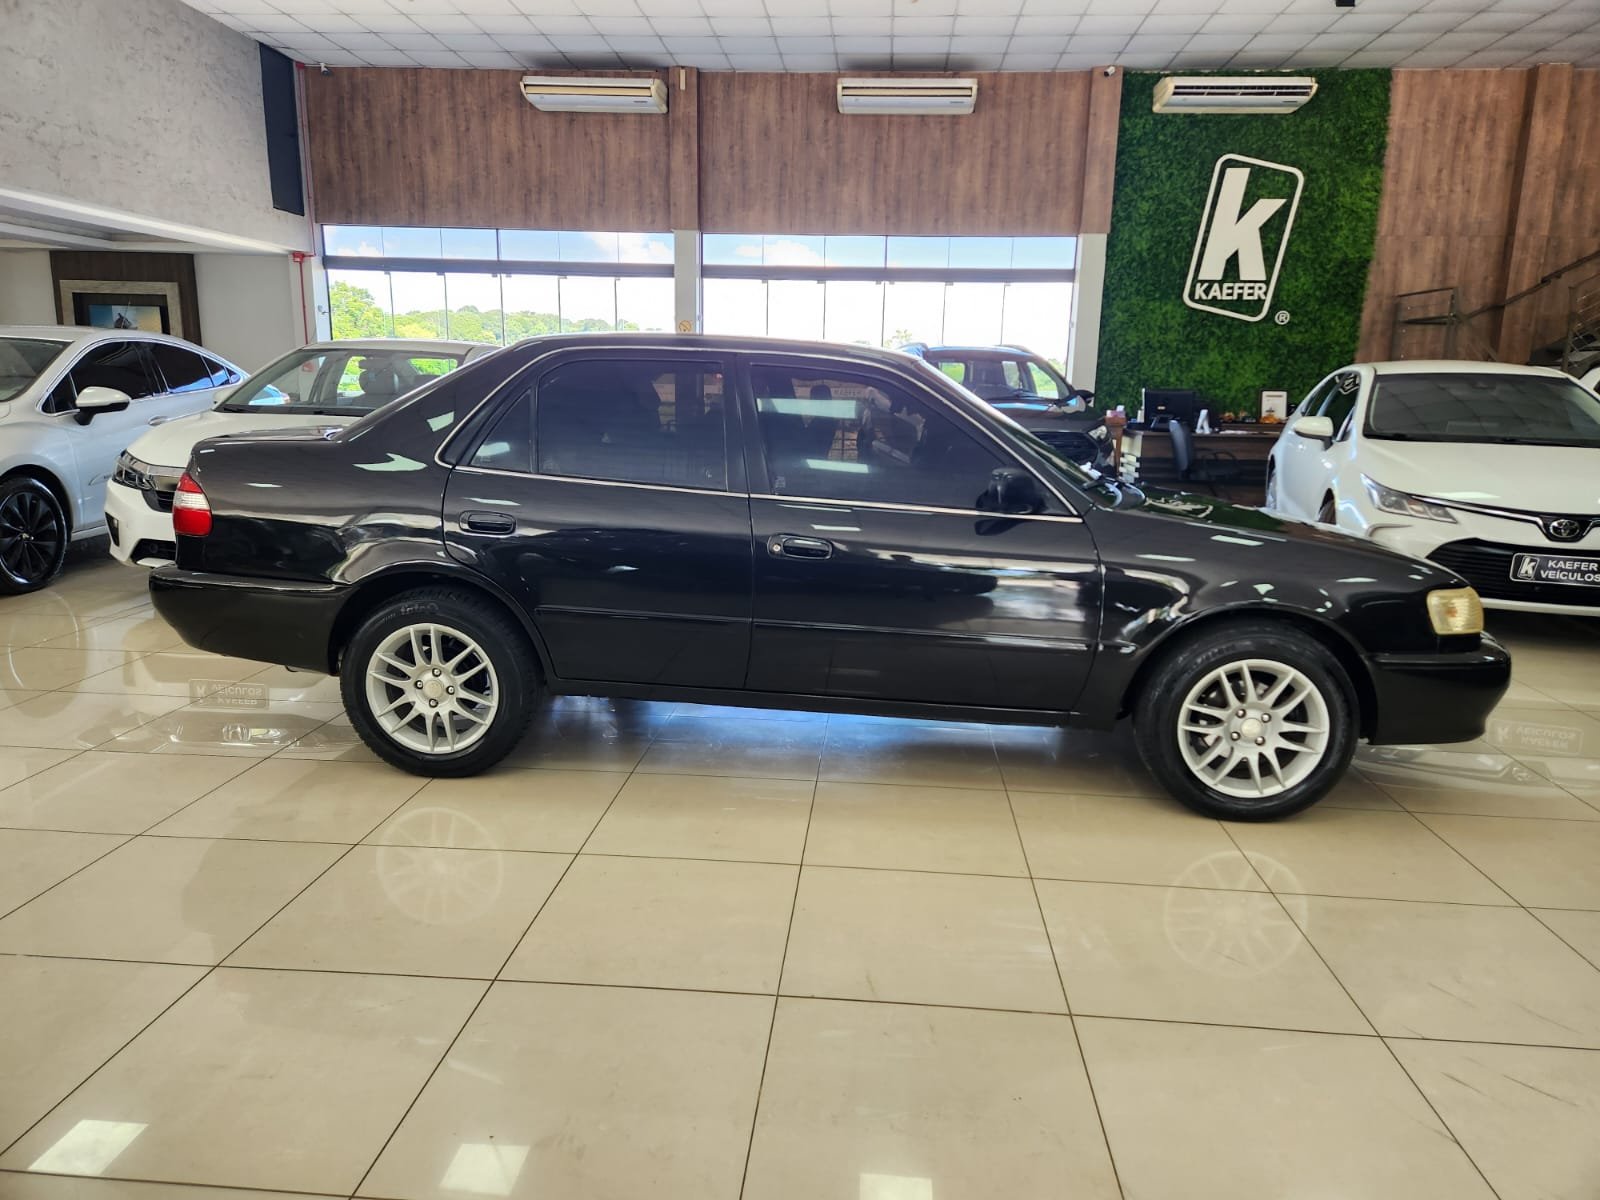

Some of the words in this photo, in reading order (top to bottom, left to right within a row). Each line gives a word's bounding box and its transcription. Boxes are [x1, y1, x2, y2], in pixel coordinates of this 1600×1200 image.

[1193, 282, 1268, 301] KAEFER
[1548, 560, 1599, 571] KAEFER
[1540, 570, 1600, 582] VEÍCULOS
